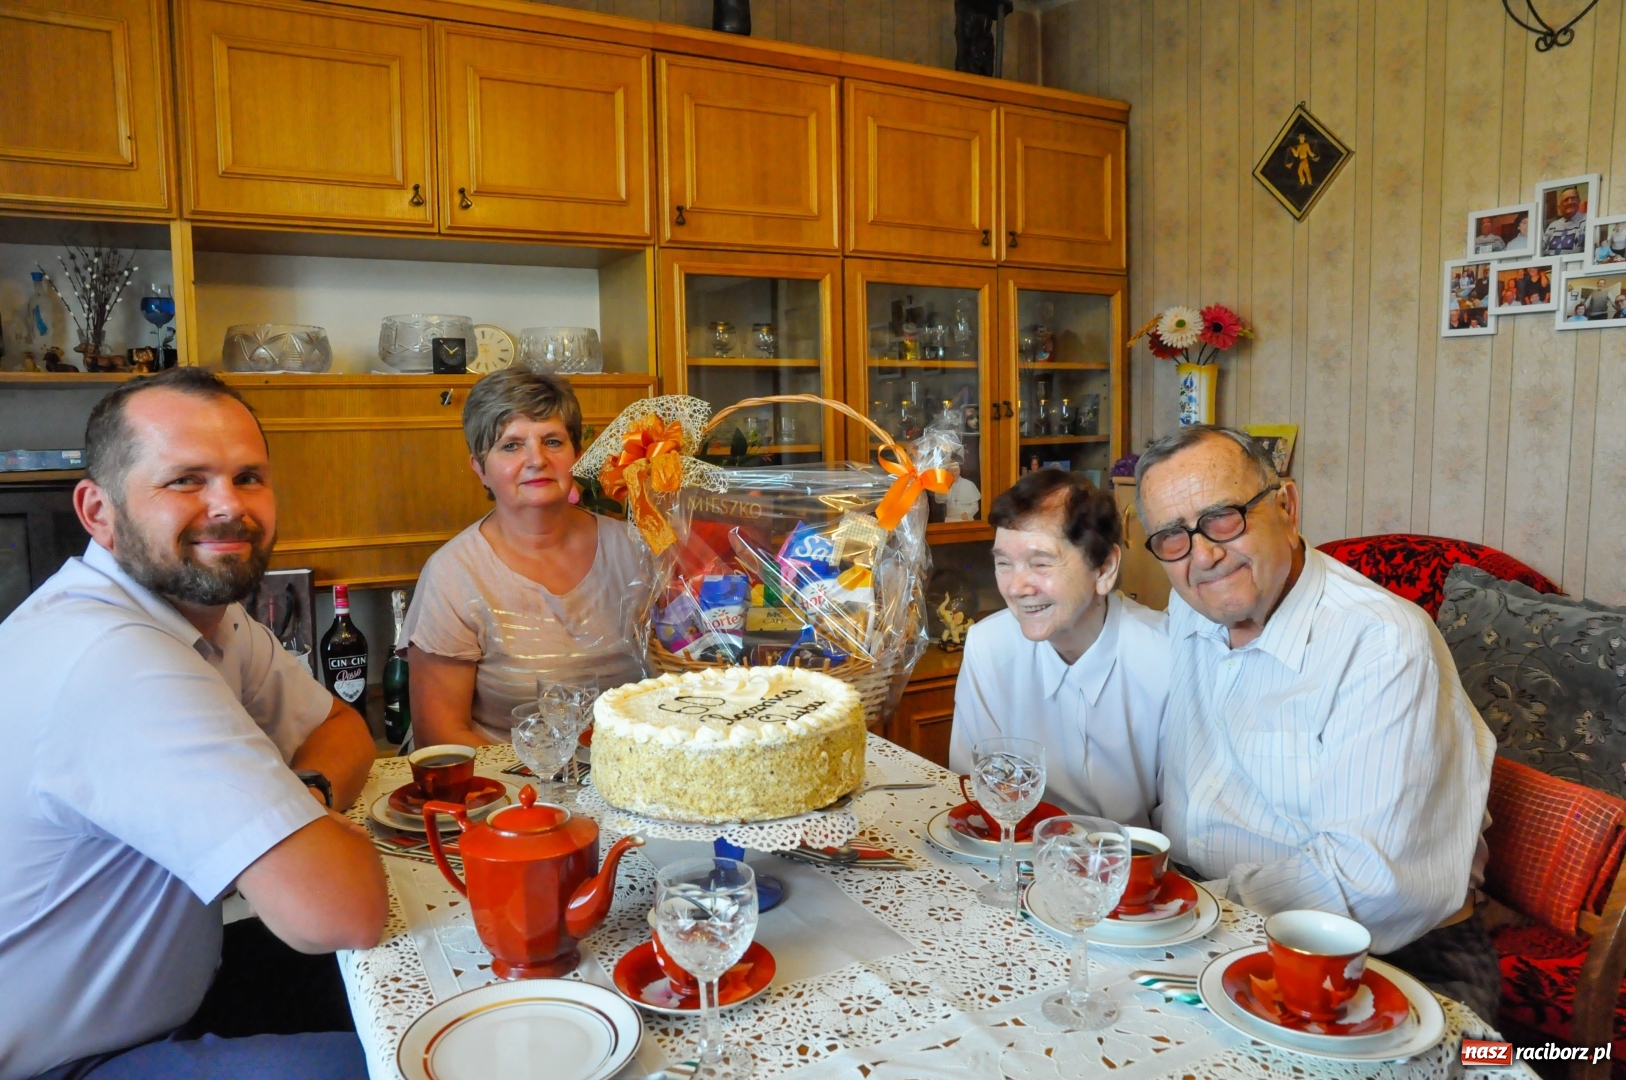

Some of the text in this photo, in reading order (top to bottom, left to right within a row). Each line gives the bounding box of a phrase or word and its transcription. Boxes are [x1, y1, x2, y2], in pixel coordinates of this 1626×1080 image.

[687, 496, 762, 519] MIESZKO
[796, 534, 831, 562] Sa
[331, 656, 367, 668] CIN CIN
[658, 695, 726, 715] 60
[699, 689, 803, 726] Rocznica
